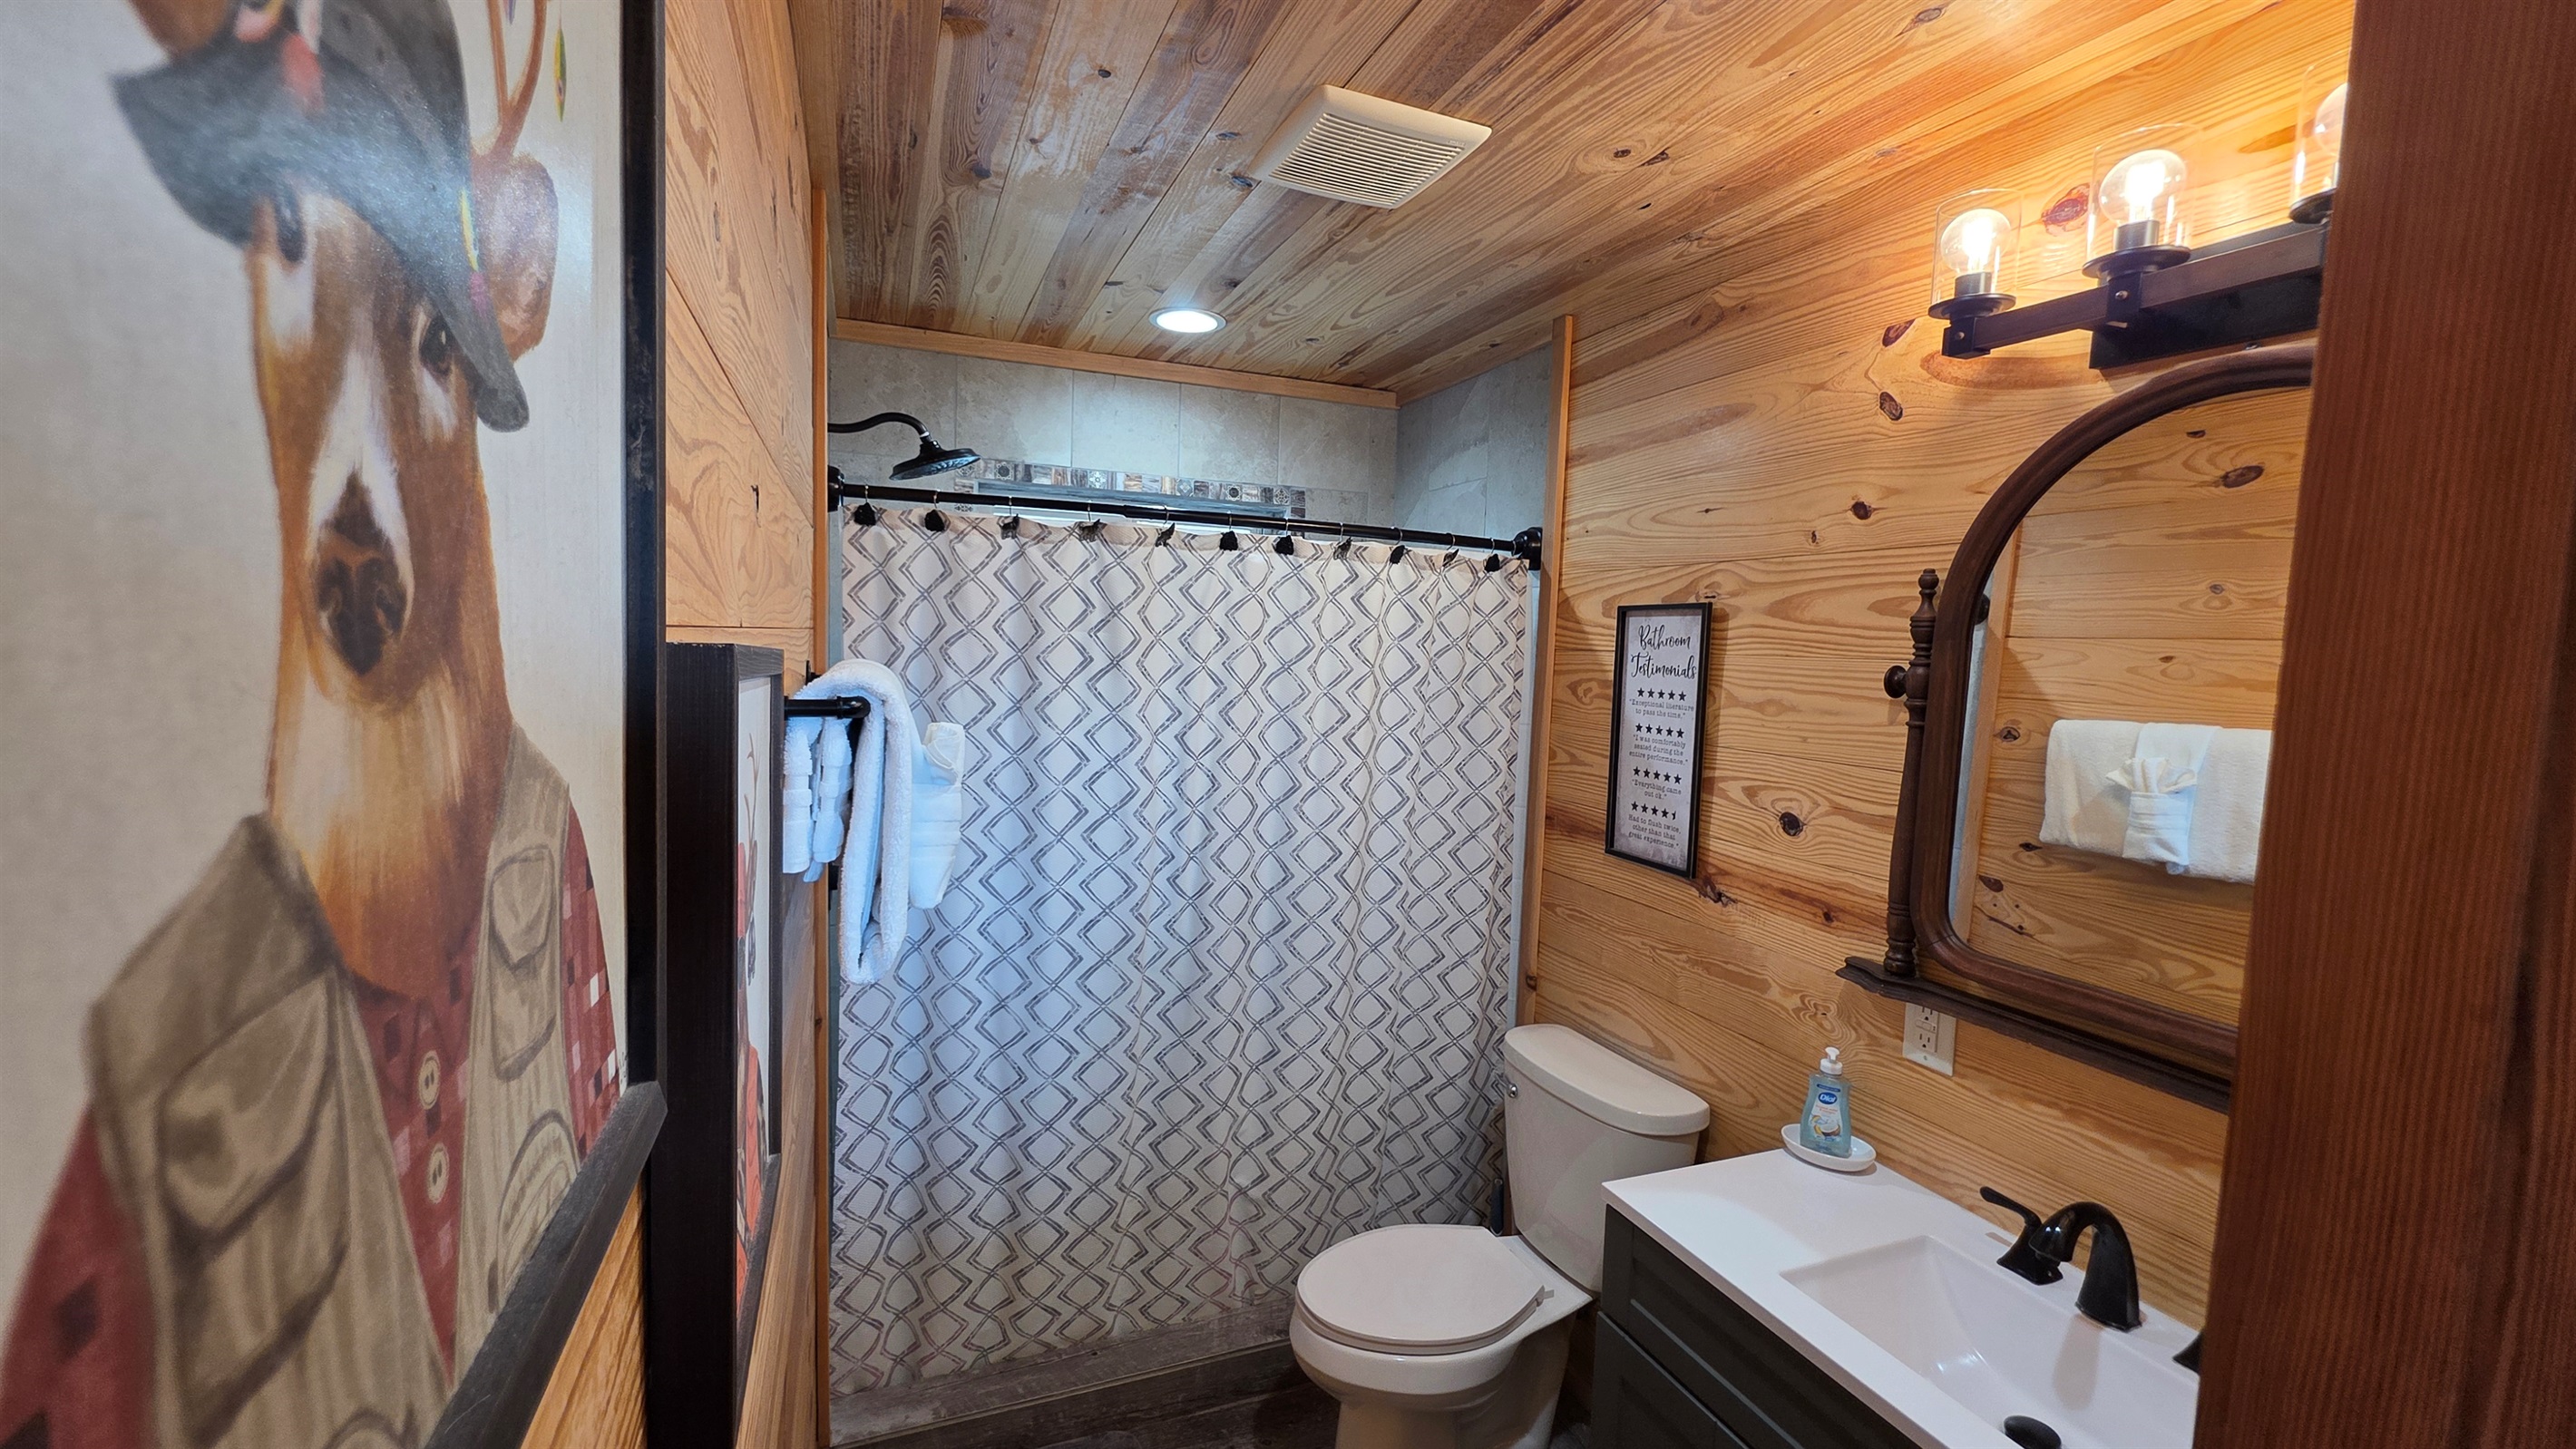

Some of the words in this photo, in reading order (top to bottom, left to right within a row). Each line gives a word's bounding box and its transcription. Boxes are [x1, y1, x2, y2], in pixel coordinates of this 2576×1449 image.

[1638, 625, 1691, 650] Bathroom
[1631, 652, 1697, 679] Testimonials
[1820, 1094, 1836, 1103] Dial
